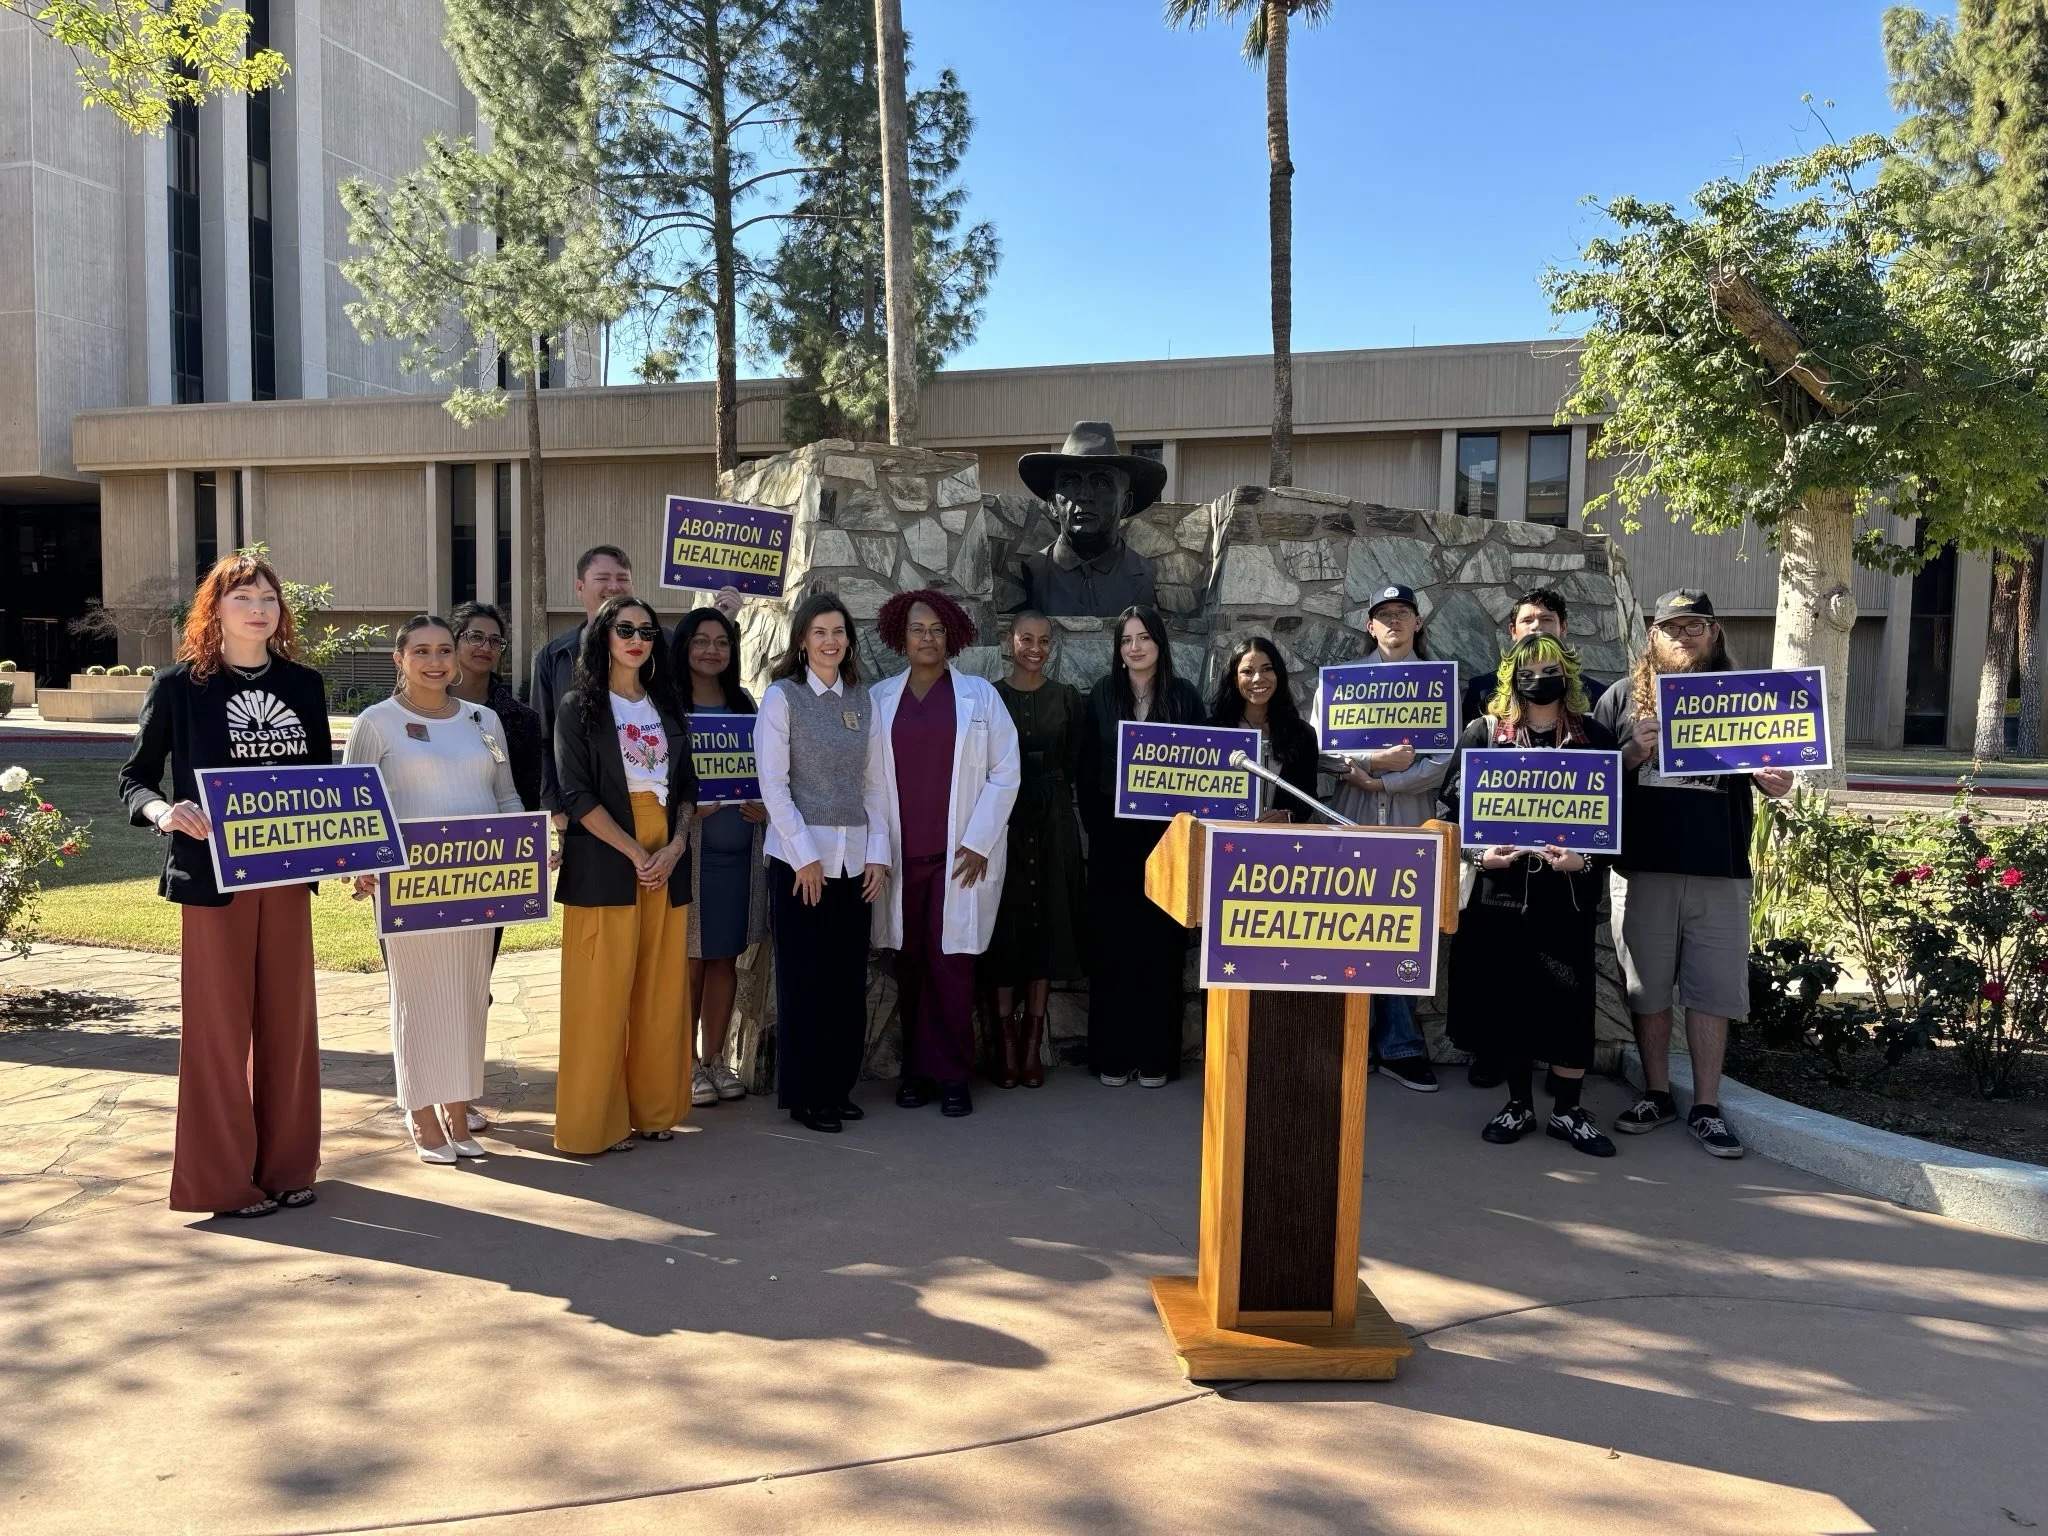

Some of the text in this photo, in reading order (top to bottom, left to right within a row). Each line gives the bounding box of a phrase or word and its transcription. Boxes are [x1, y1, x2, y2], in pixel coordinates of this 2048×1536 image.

[678, 518, 783, 547] ABORTION IS
[677, 543, 779, 572] HEALTHCARE
[1332, 680, 1444, 701] ABORTION IS
[1673, 689, 1809, 716] ABORTION IS
[1333, 706, 1443, 726] HEALTHCARE
[228, 725, 307, 742] ROGRESS
[691, 732, 740, 749] RTION
[1676, 718, 1809, 744] HEALTHCARE
[696, 756, 757, 775] LTHCAR
[1132, 743, 1222, 766] ABORTION
[1132, 769, 1245, 794] HEALTHCARE
[1477, 769, 1578, 790] ABORTION
[1587, 772, 1606, 791] IS
[225, 786, 374, 816] ABORTION IS
[1477, 797, 1604, 820] HEALTHCARE
[233, 815, 380, 850] HEALTHCARE
[409, 838, 505, 866] BORTION
[515, 836, 535, 858] IS
[396, 867, 534, 900] HEALTHCARE
[1228, 863, 1418, 899] ABORTION IS
[1229, 908, 1414, 944] HEALTHCARE
